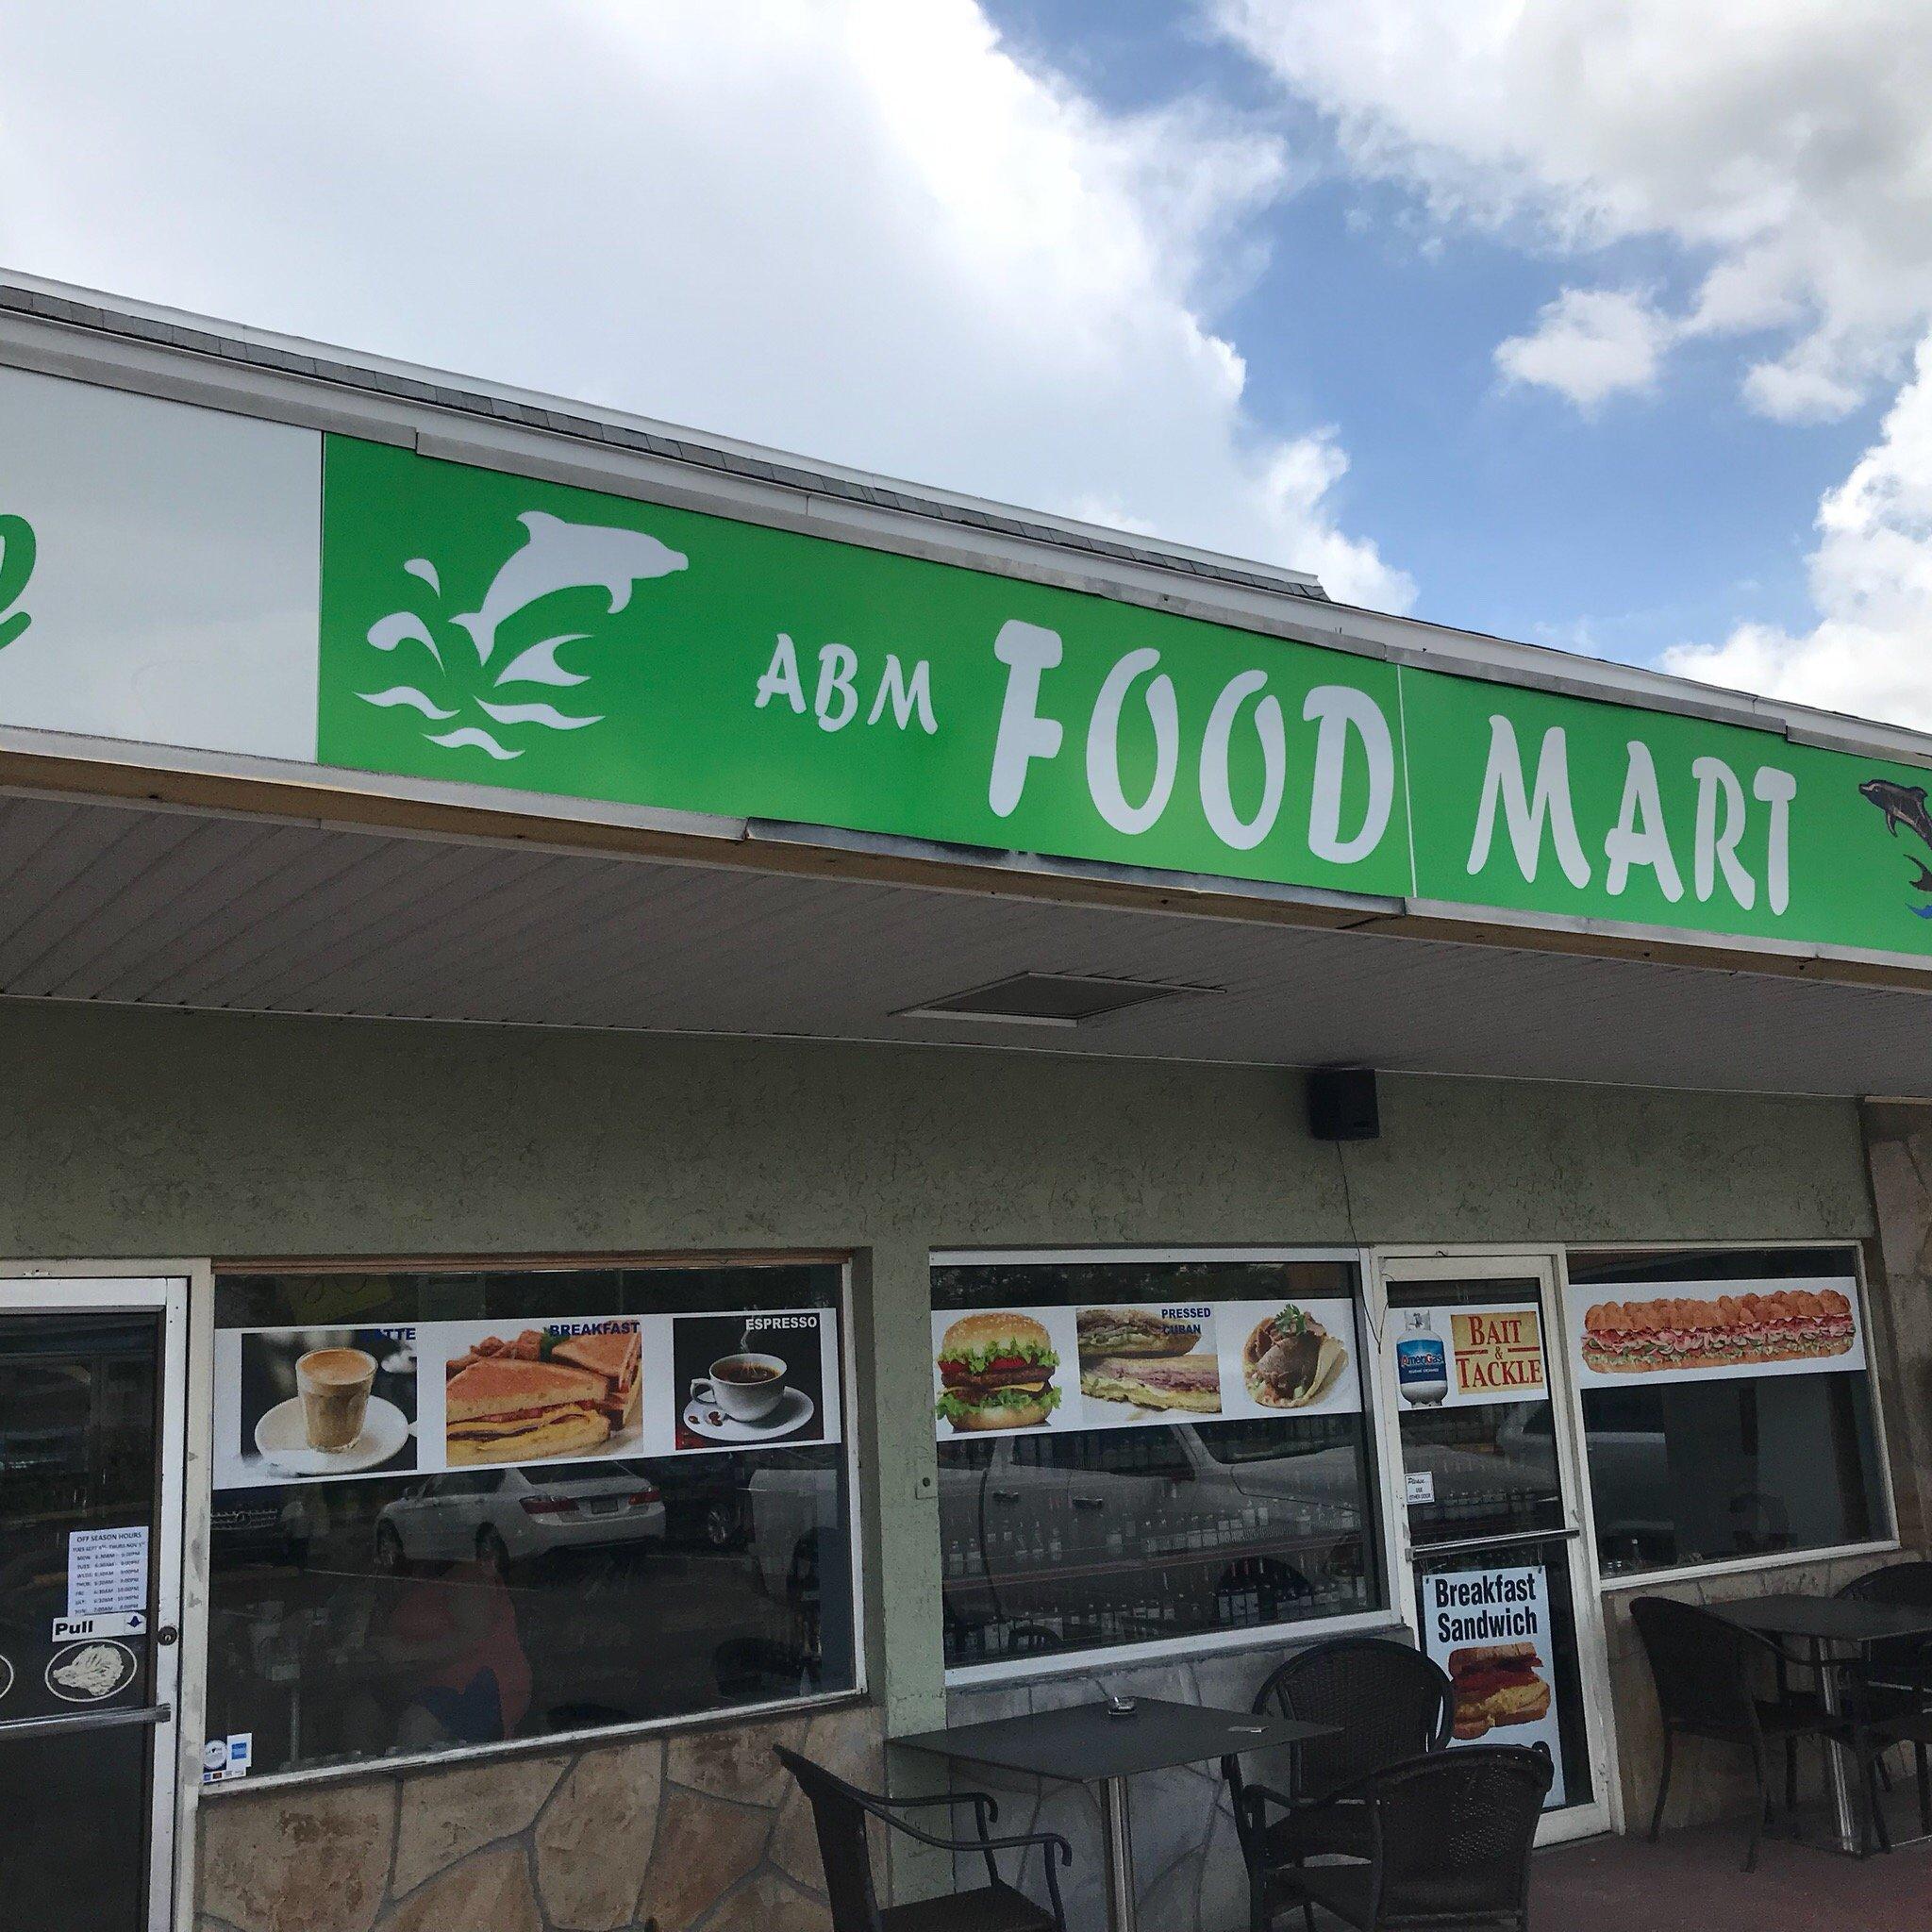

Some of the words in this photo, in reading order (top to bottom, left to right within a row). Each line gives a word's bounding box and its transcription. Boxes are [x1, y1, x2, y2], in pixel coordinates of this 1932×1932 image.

[755, 633, 938, 735] ABM
[989, 619, 1394, 864] FOOD
[1467, 714, 1796, 916] MART
[1161, 1307, 1211, 1319] PRESSED
[549, 1322, 641, 1337] BREAKFAST
[745, 1316, 818, 1331] ESPRESSO
[1468, 1316, 1522, 1345] BAIT
[1494, 1346, 1503, 1359] &
[1456, 1358, 1542, 1388] TACKLE
[91, 1534, 117, 1542] SEASON
[1435, 1573, 1536, 1607] Breakfast
[55, 1620, 93, 1636] Pull
[1438, 1606, 1538, 1643] Sandwich
